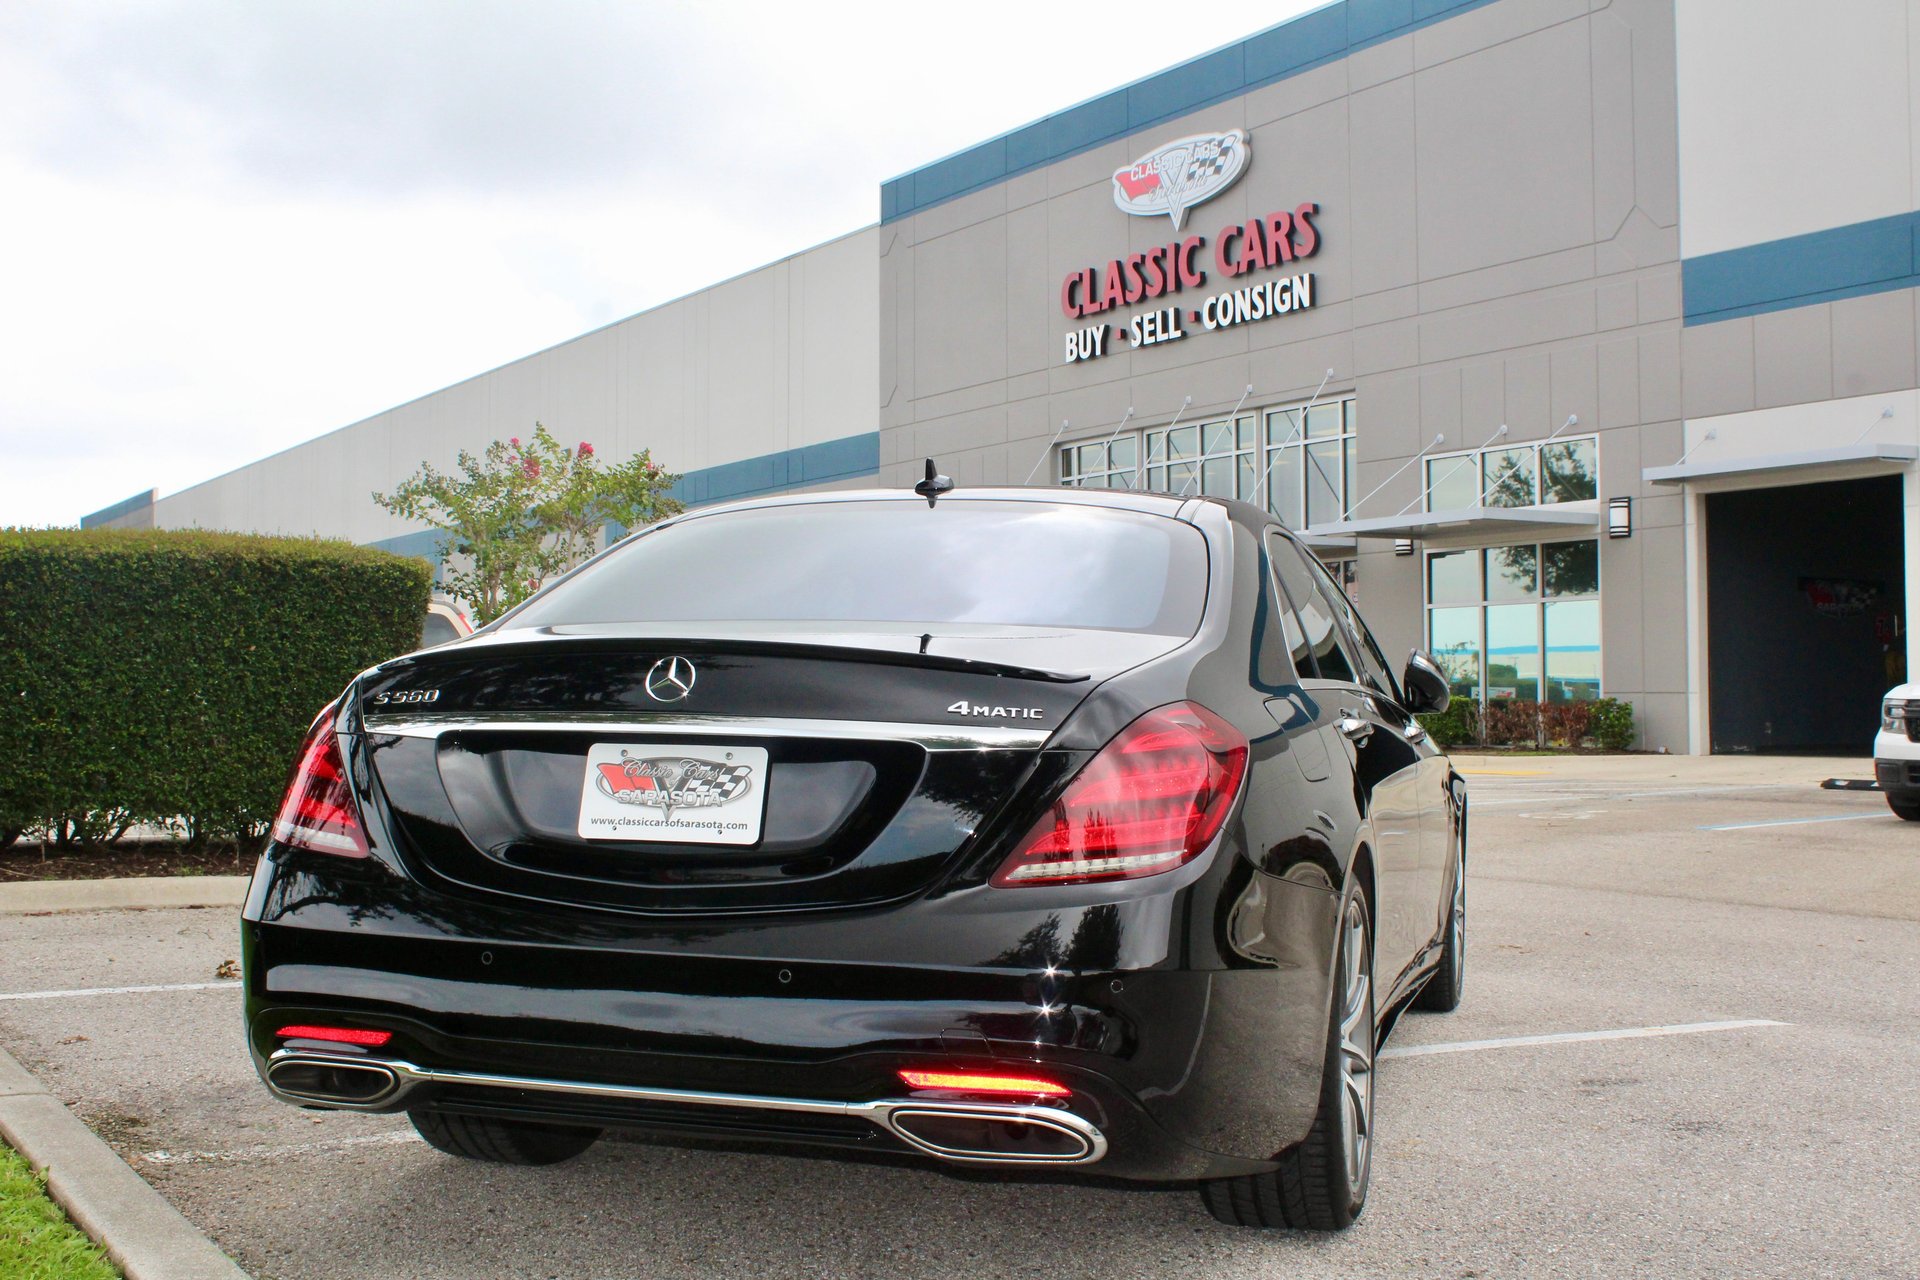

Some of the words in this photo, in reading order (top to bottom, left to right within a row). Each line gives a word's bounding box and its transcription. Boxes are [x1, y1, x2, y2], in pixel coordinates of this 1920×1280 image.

[1130, 152, 1185, 181] CLASSIC
[1185, 141, 1220, 164] CARS
[1061, 235, 1205, 319] CLASSIC
[1214, 202, 1319, 277] CARS
[1065, 324, 1108, 362] BUY
[1131, 307, 1185, 348] SELL
[1202, 273, 1314, 330] CONSIGN
[947, 700, 1044, 719] 4MATIC
[621, 757, 674, 779] Classic
[617, 789, 723, 808] SARASOTA
[591, 815, 748, 831] www.classiccarsofsarasota.com
